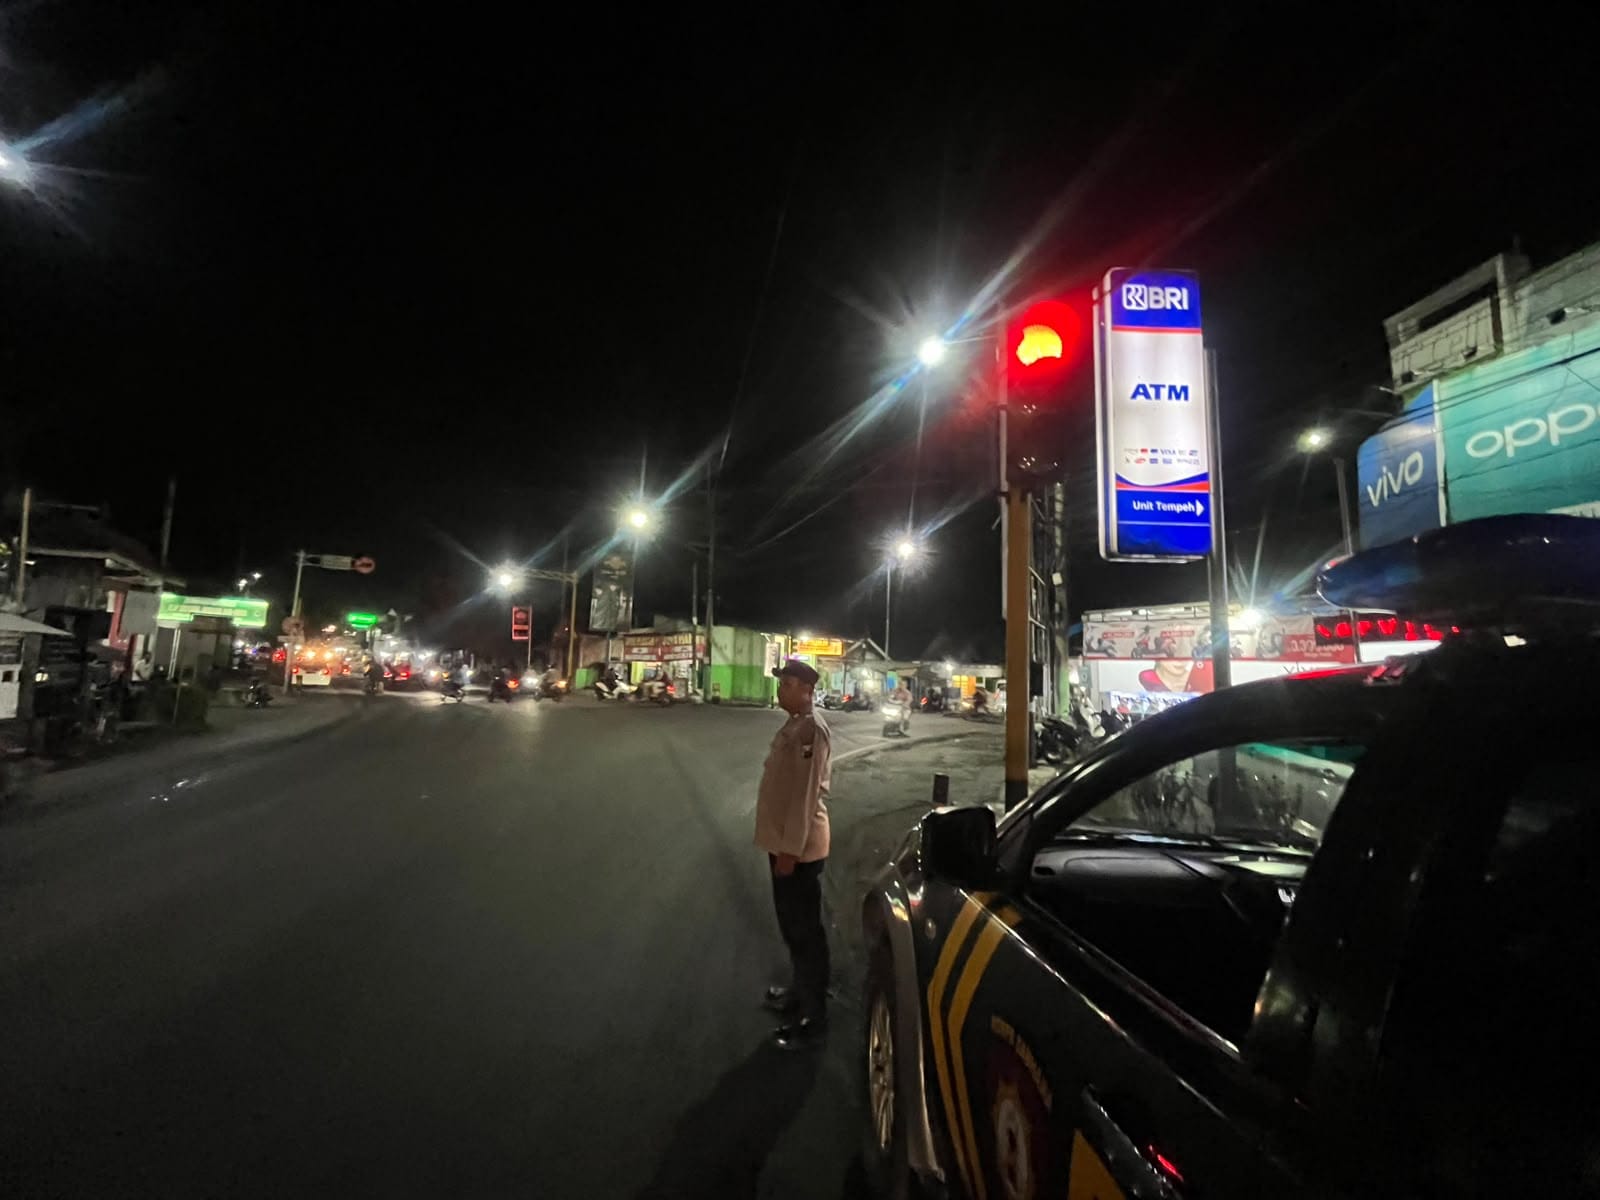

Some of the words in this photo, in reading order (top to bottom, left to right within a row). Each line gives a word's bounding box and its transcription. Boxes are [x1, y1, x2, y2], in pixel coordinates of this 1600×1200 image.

[1148, 286, 1189, 311] BRI
[1130, 383, 1189, 401] ATM
[1465, 402, 1600, 458] opp
[1367, 450, 1424, 508] vivo
[1132, 500, 1154, 511] Unit
[1155, 501, 1195, 514] Tempeh
